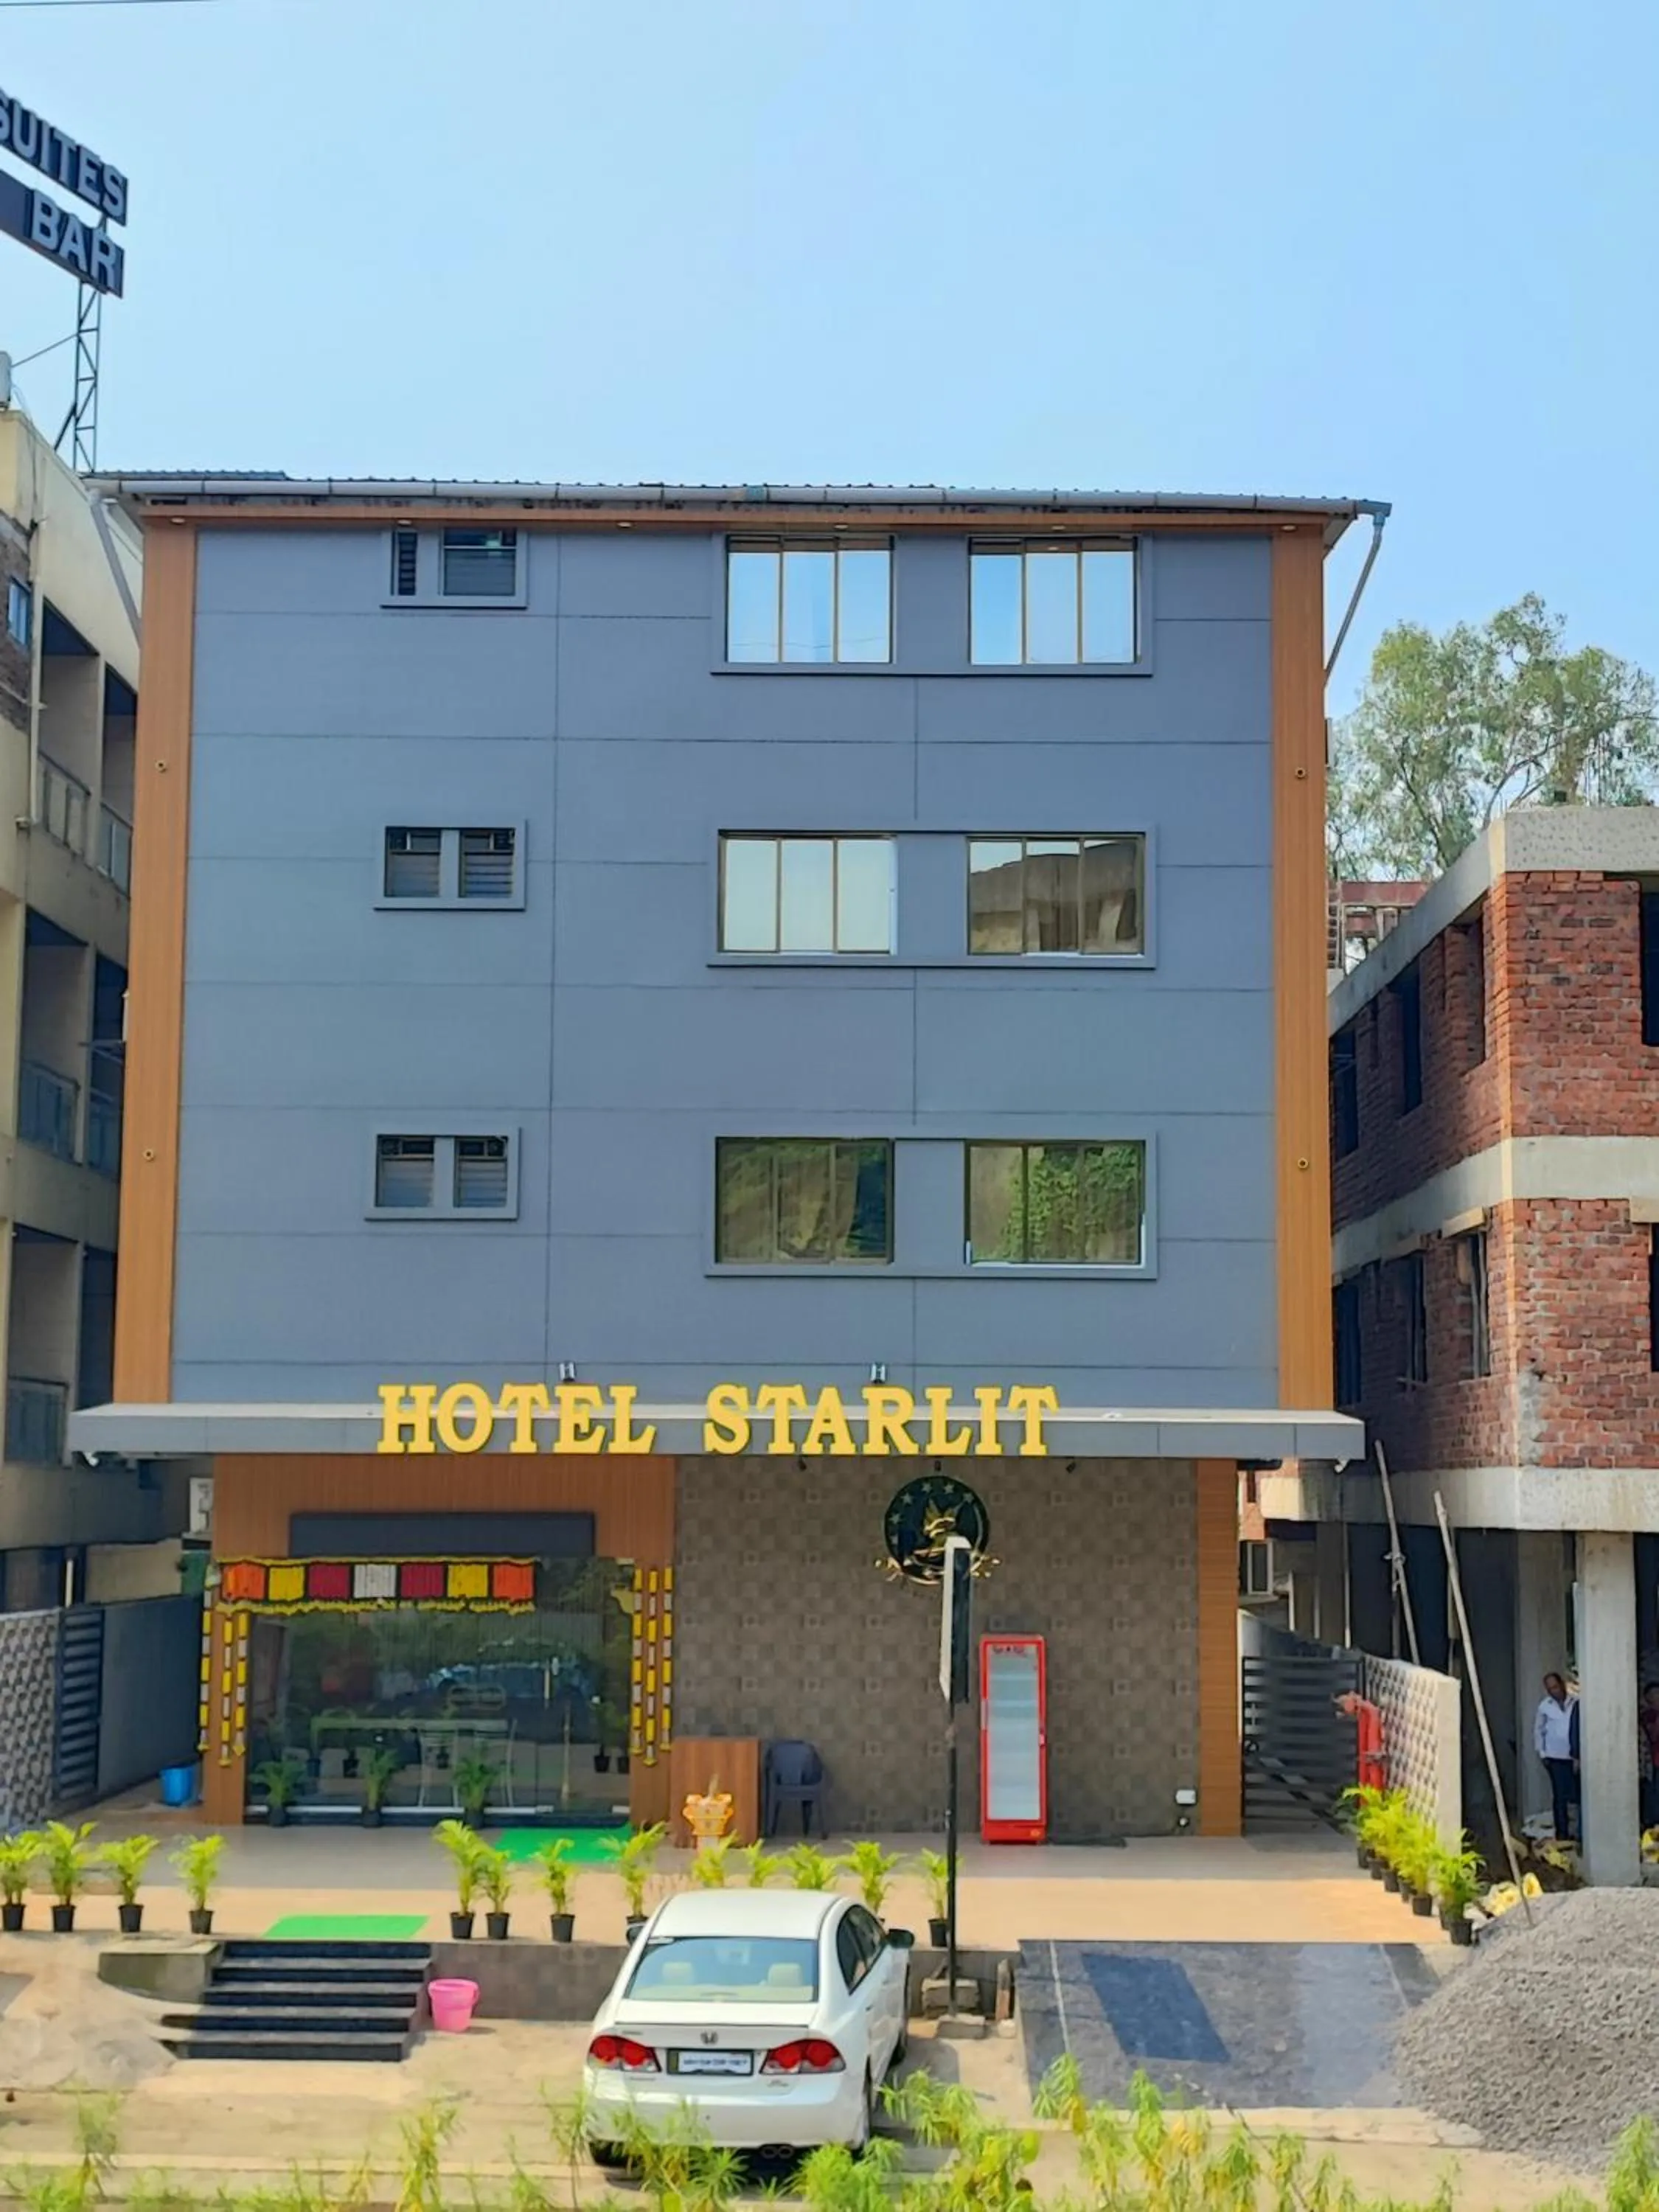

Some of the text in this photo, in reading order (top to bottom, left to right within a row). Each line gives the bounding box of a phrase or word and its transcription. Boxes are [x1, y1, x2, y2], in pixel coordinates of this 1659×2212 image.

[30, 189, 118, 291] BAR
[377, 1382, 1060, 1455] HOTEL STARLIT
